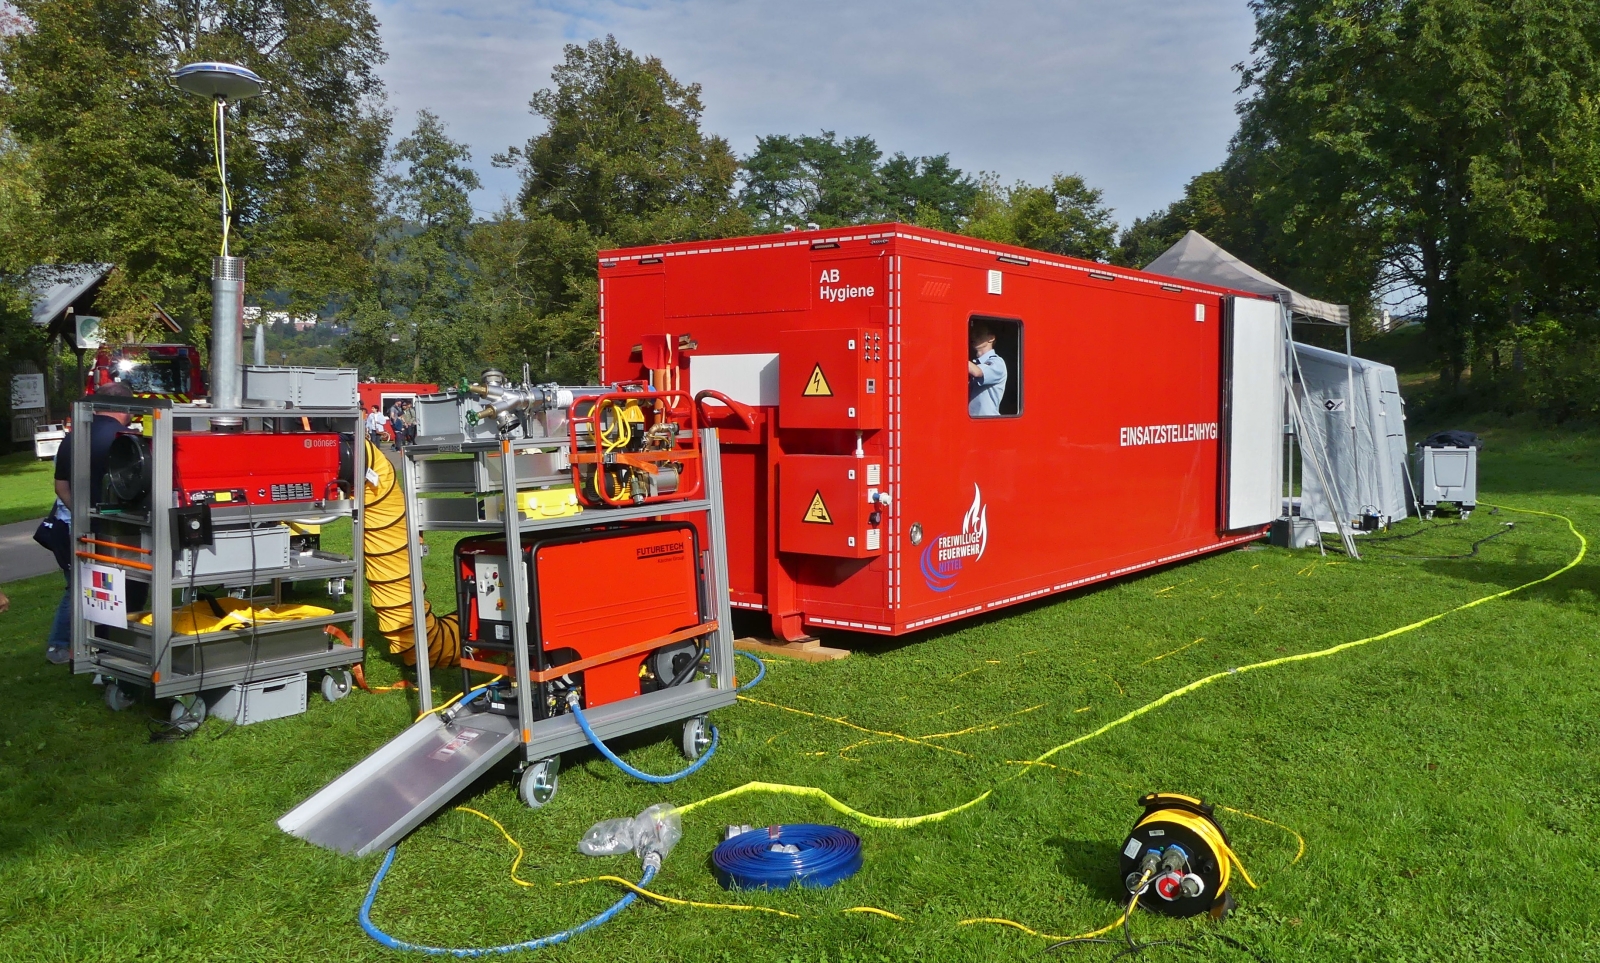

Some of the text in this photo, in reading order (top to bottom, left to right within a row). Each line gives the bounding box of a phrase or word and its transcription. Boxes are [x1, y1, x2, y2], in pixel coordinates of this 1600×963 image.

[819, 269, 840, 283] AB
[820, 284, 874, 302] Hygiene
[636, 542, 684, 555] FUTURETECH
[938, 532, 981, 549] FREIWILLIGE
[938, 543, 980, 561] FEUERWEHR
[939, 558, 962, 573] NITTEL
